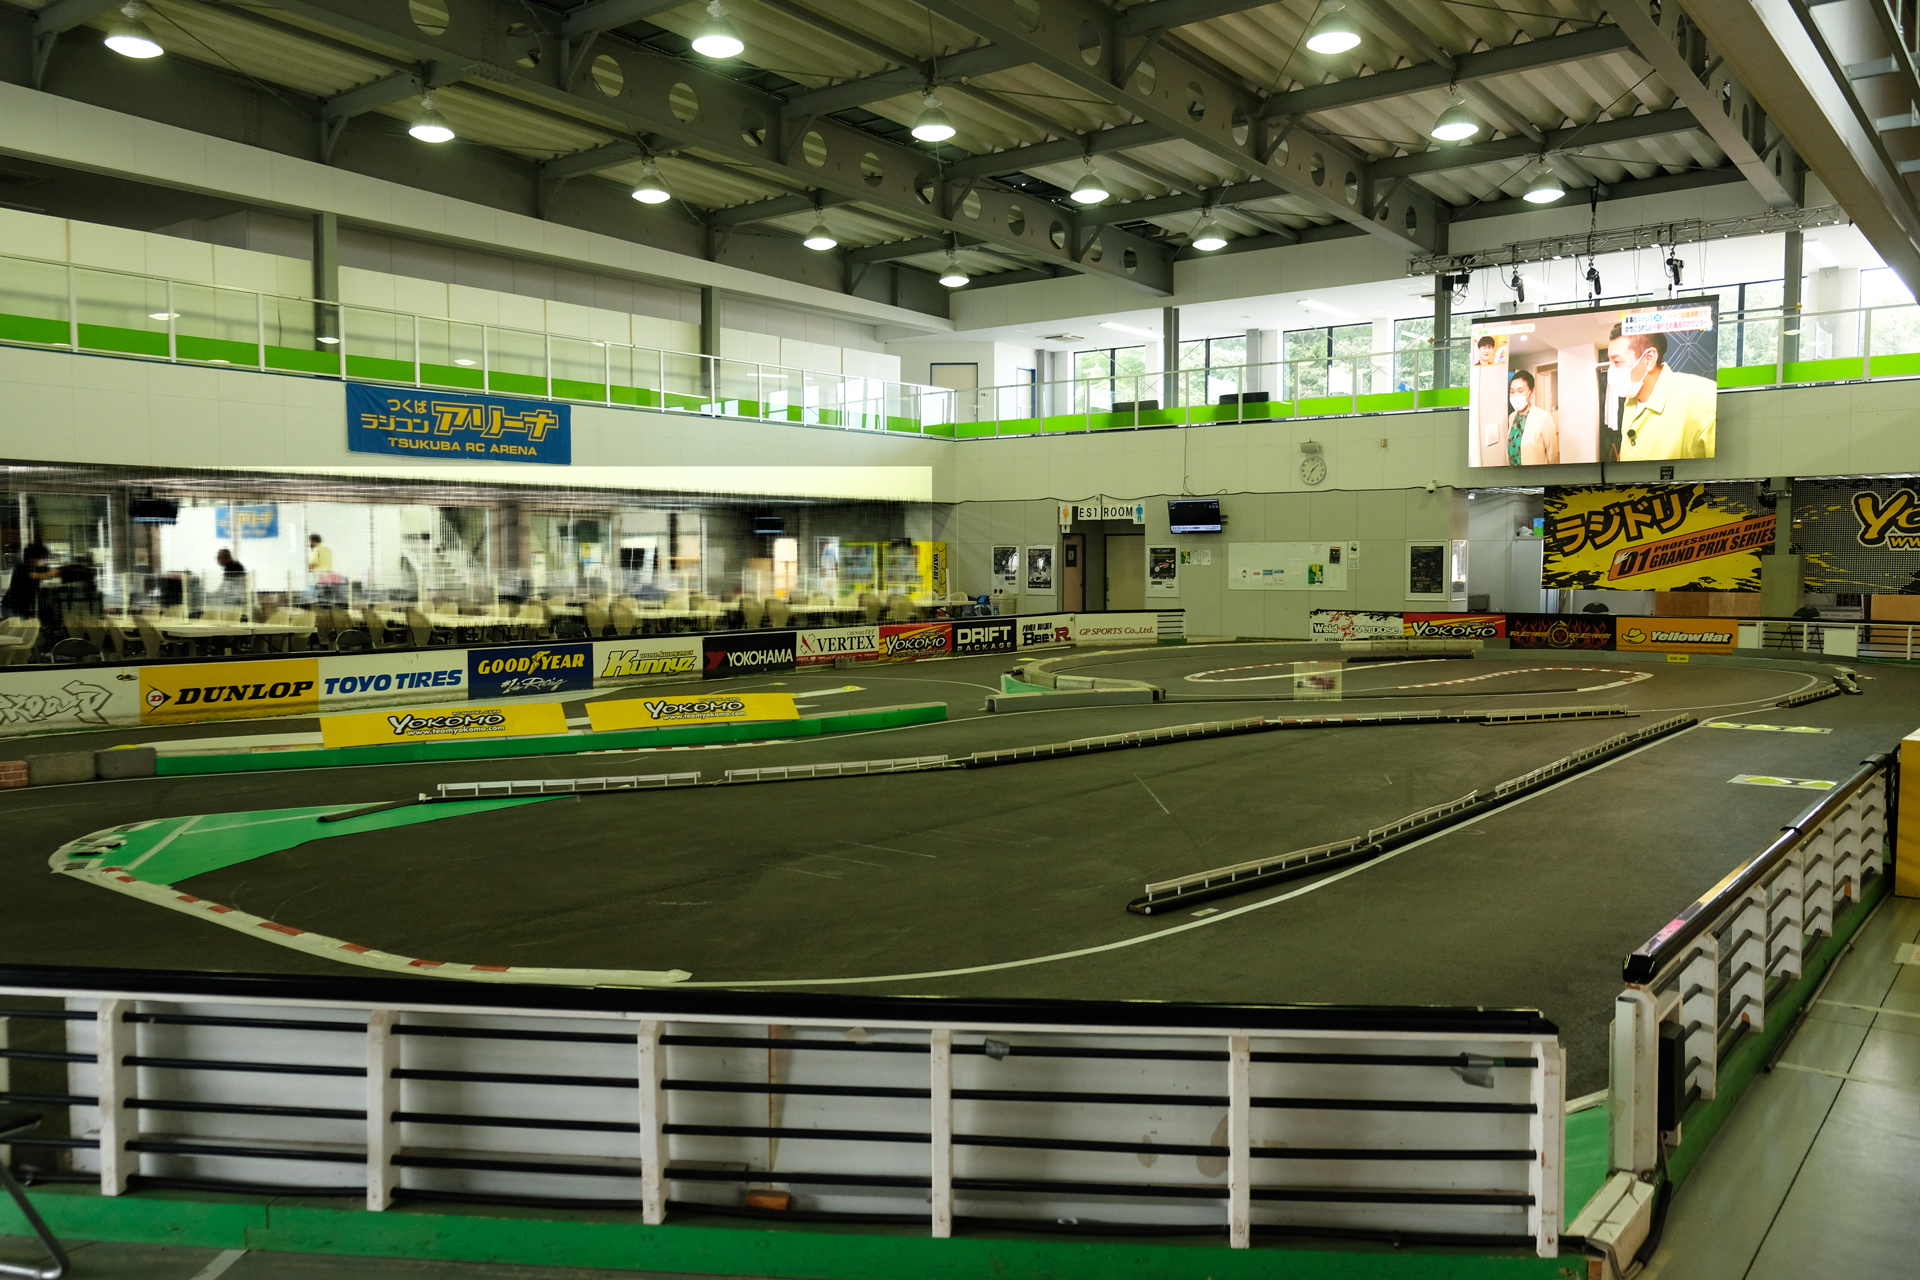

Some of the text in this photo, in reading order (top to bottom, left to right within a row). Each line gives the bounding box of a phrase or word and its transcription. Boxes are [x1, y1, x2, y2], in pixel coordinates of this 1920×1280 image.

[387, 399, 427, 414] つくば
[361, 413, 429, 434] ラジコン
[431, 400, 558, 442] アリーナ
[388, 437, 538, 456] TSUKUBA RC ARENA
[1104, 506, 1132, 517] ROOM
[1554, 492, 1683, 555] ラジドリ
[1654, 528, 1740, 553] PROFESSIONAL
[1618, 528, 1776, 576] D1 GRAND PRIX SERIES
[957, 626, 1012, 644] DRIFT
[1080, 626, 1154, 636] GP SPORTS Co.,Ltd.
[1313, 623, 1338, 633] Weld
[1412, 621, 1498, 638] YOKOMO
[817, 635, 875, 652] VERTEX
[885, 634, 946, 657] YOKOMO
[957, 642, 1012, 652] PACKAGE
[478, 651, 585, 674] GOODYEAR
[727, 648, 794, 667] YOKOHAMA
[324, 670, 463, 694] TOYO TIRES
[522, 678, 568, 691] Racing
[174, 680, 314, 705] DUNLOP
[644, 700, 744, 719] YOKOMO
[662, 710, 746, 720] www.teamyokomo.com
[388, 714, 506, 735] YOKOMO
[406, 725, 506, 736] www.teamyokomo.com
